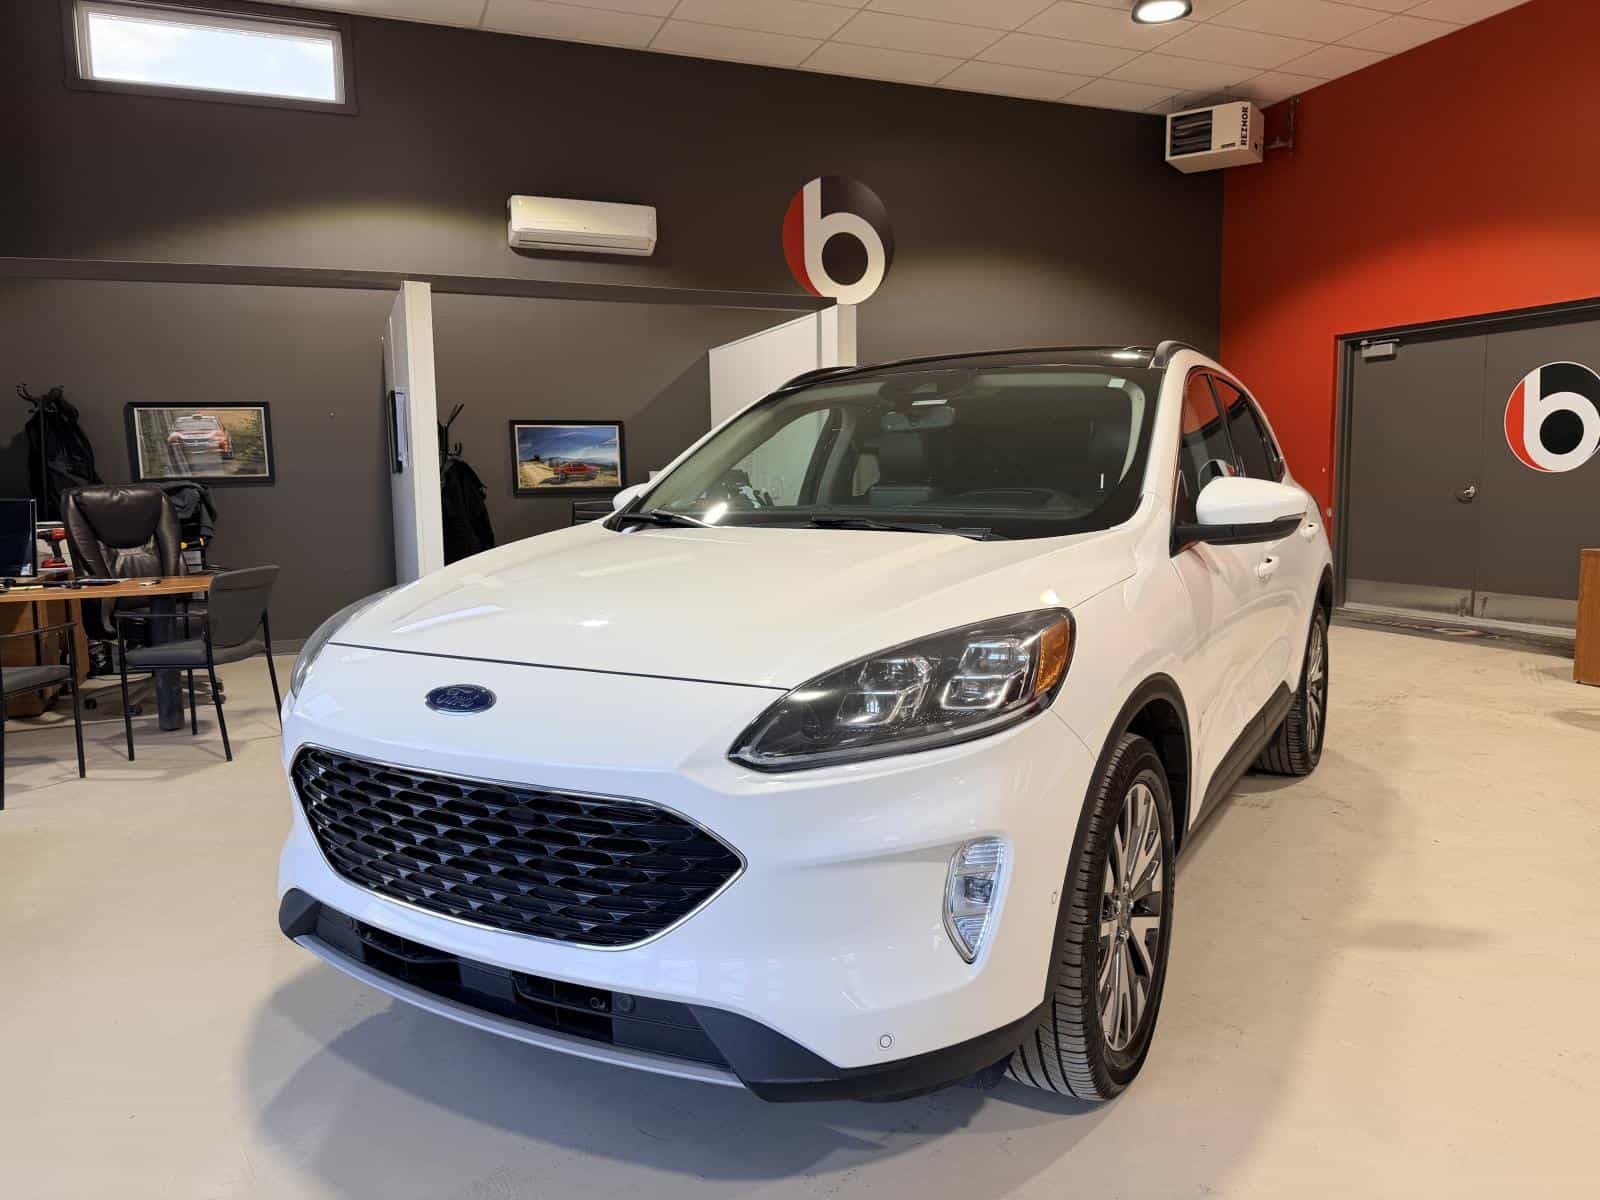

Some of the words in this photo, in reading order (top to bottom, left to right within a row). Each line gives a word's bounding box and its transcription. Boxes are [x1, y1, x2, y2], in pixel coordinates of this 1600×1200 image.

[1240, 106, 1249, 146] REZNOR
[803, 177, 886, 304] b
[1523, 367, 1600, 472] b
[436, 687, 480, 708] Ford
